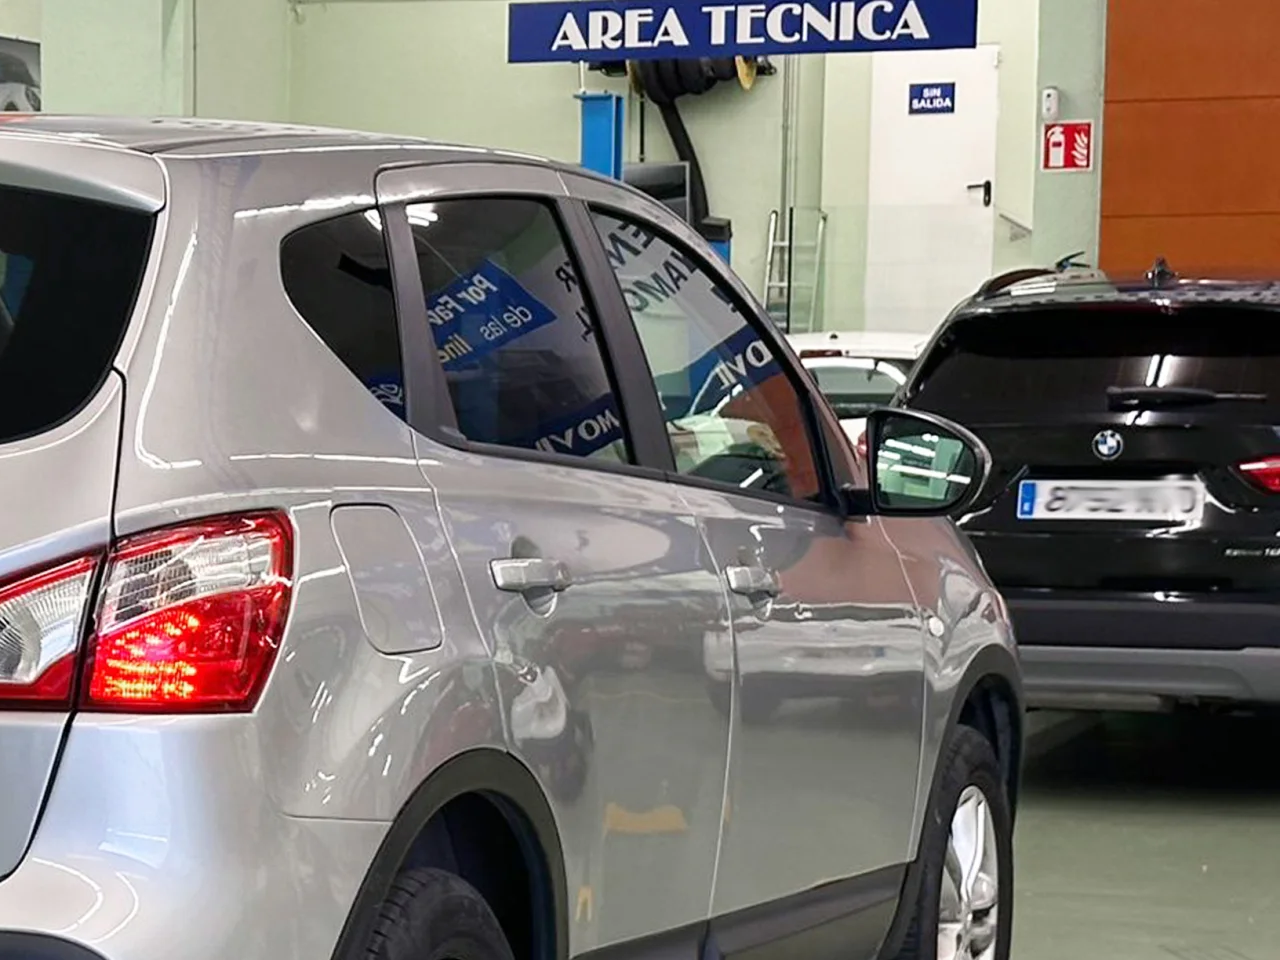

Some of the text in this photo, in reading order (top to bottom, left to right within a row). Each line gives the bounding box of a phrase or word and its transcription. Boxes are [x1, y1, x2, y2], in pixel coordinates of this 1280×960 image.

[551, 0, 930, 51] AREA TECNICA
[922, 87, 941, 98] SIN
[911, 97, 952, 109] SALIDA
